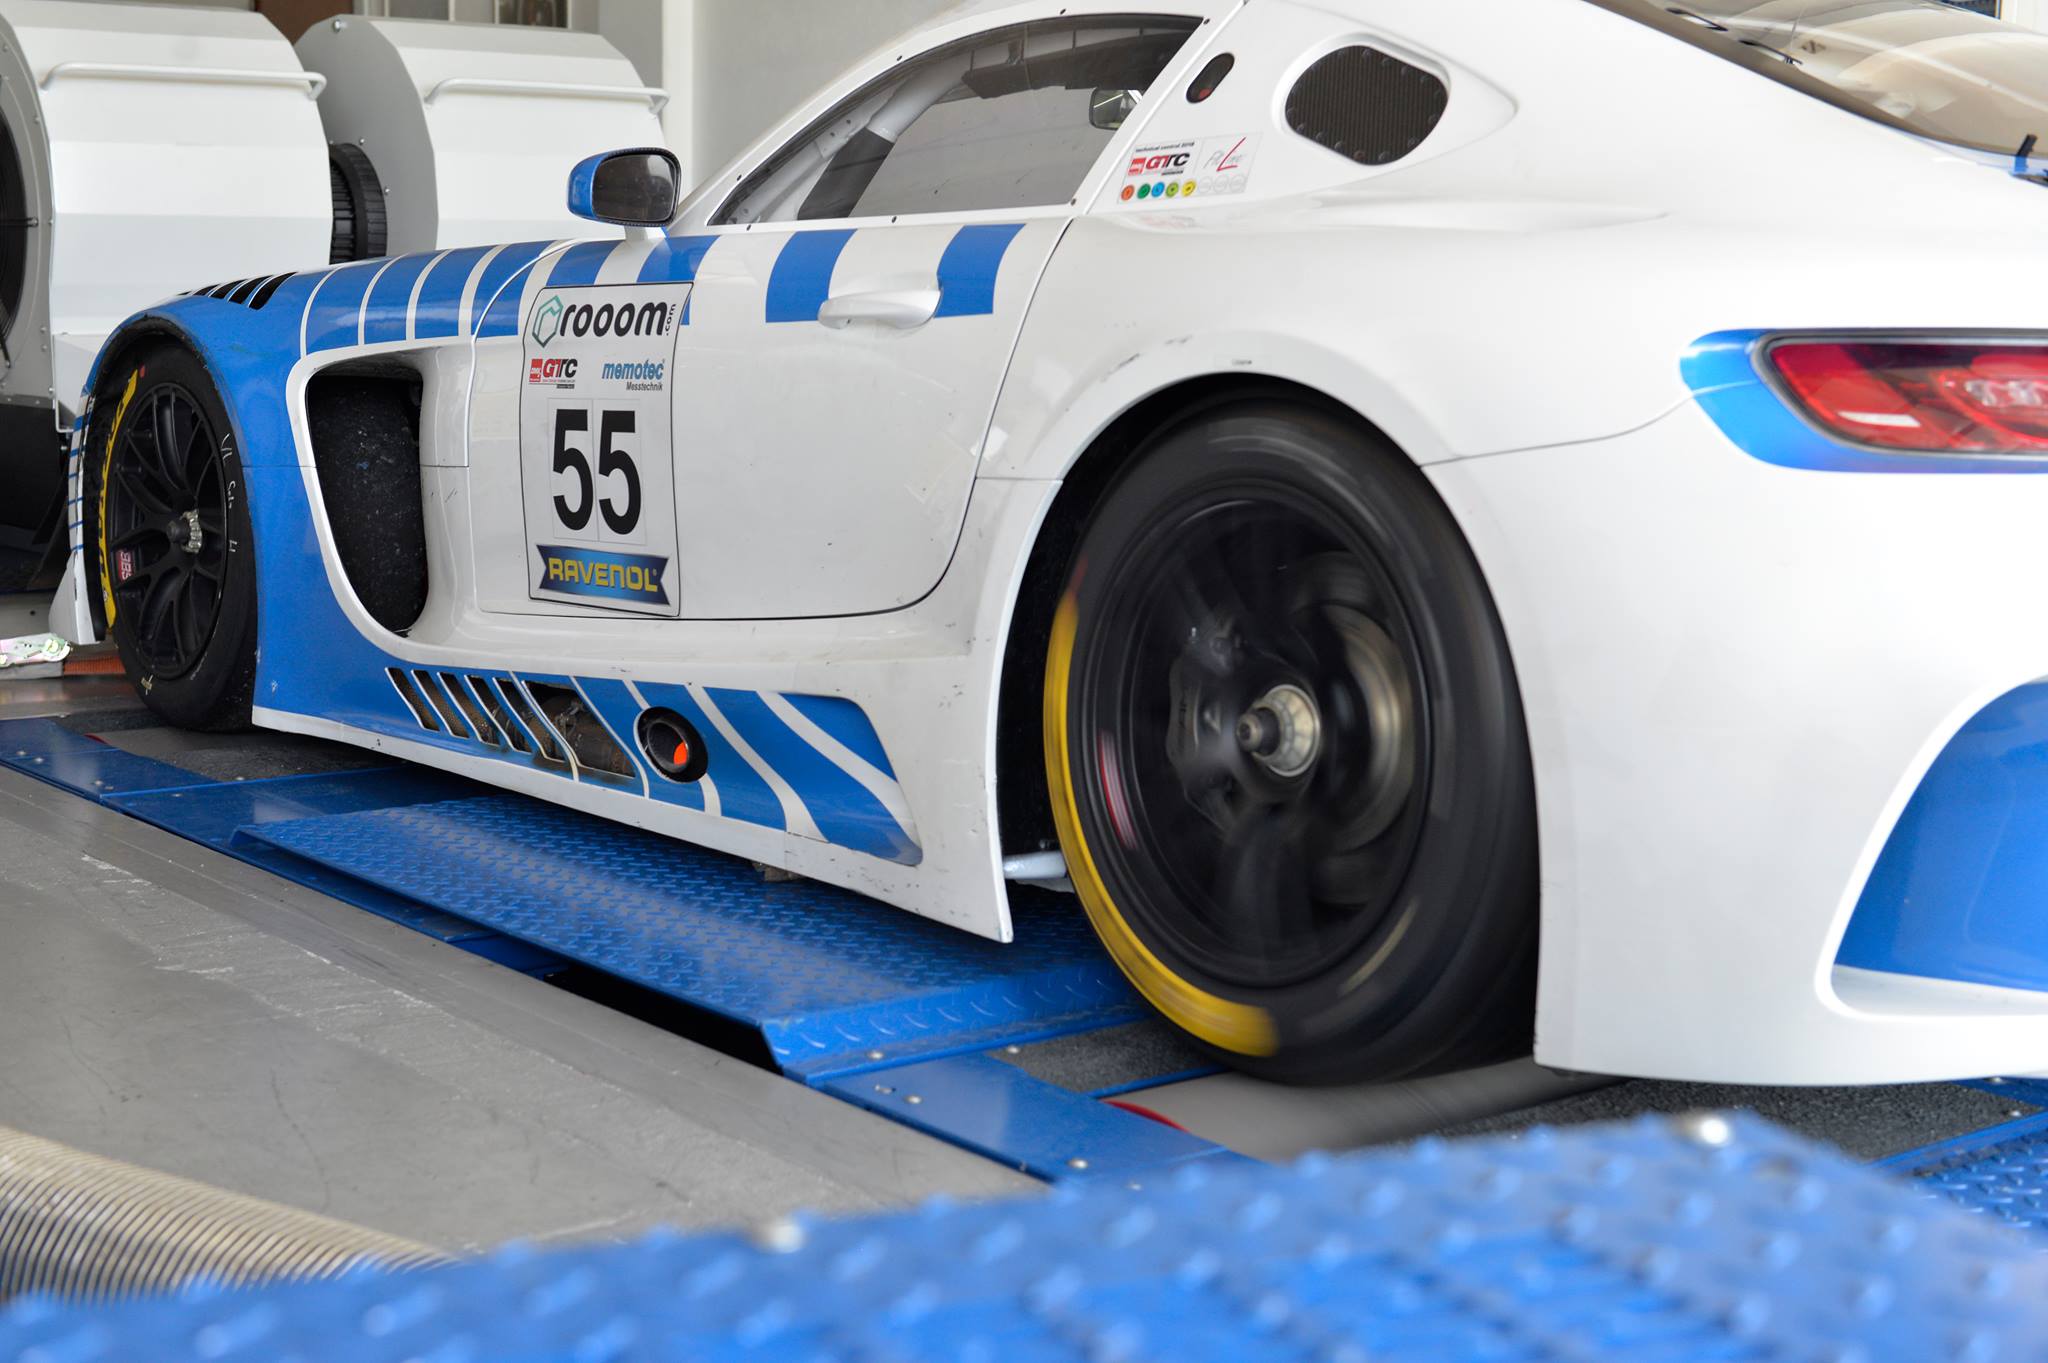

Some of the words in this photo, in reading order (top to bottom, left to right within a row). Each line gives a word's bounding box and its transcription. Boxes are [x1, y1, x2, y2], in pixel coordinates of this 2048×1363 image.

[560, 302, 667, 337] rooom
[543, 358, 578, 378] GTC
[601, 359, 664, 380] memotec
[626, 382, 663, 391] Messtechnik
[553, 408, 642, 536] 55
[548, 558, 658, 592] RAVENOL
